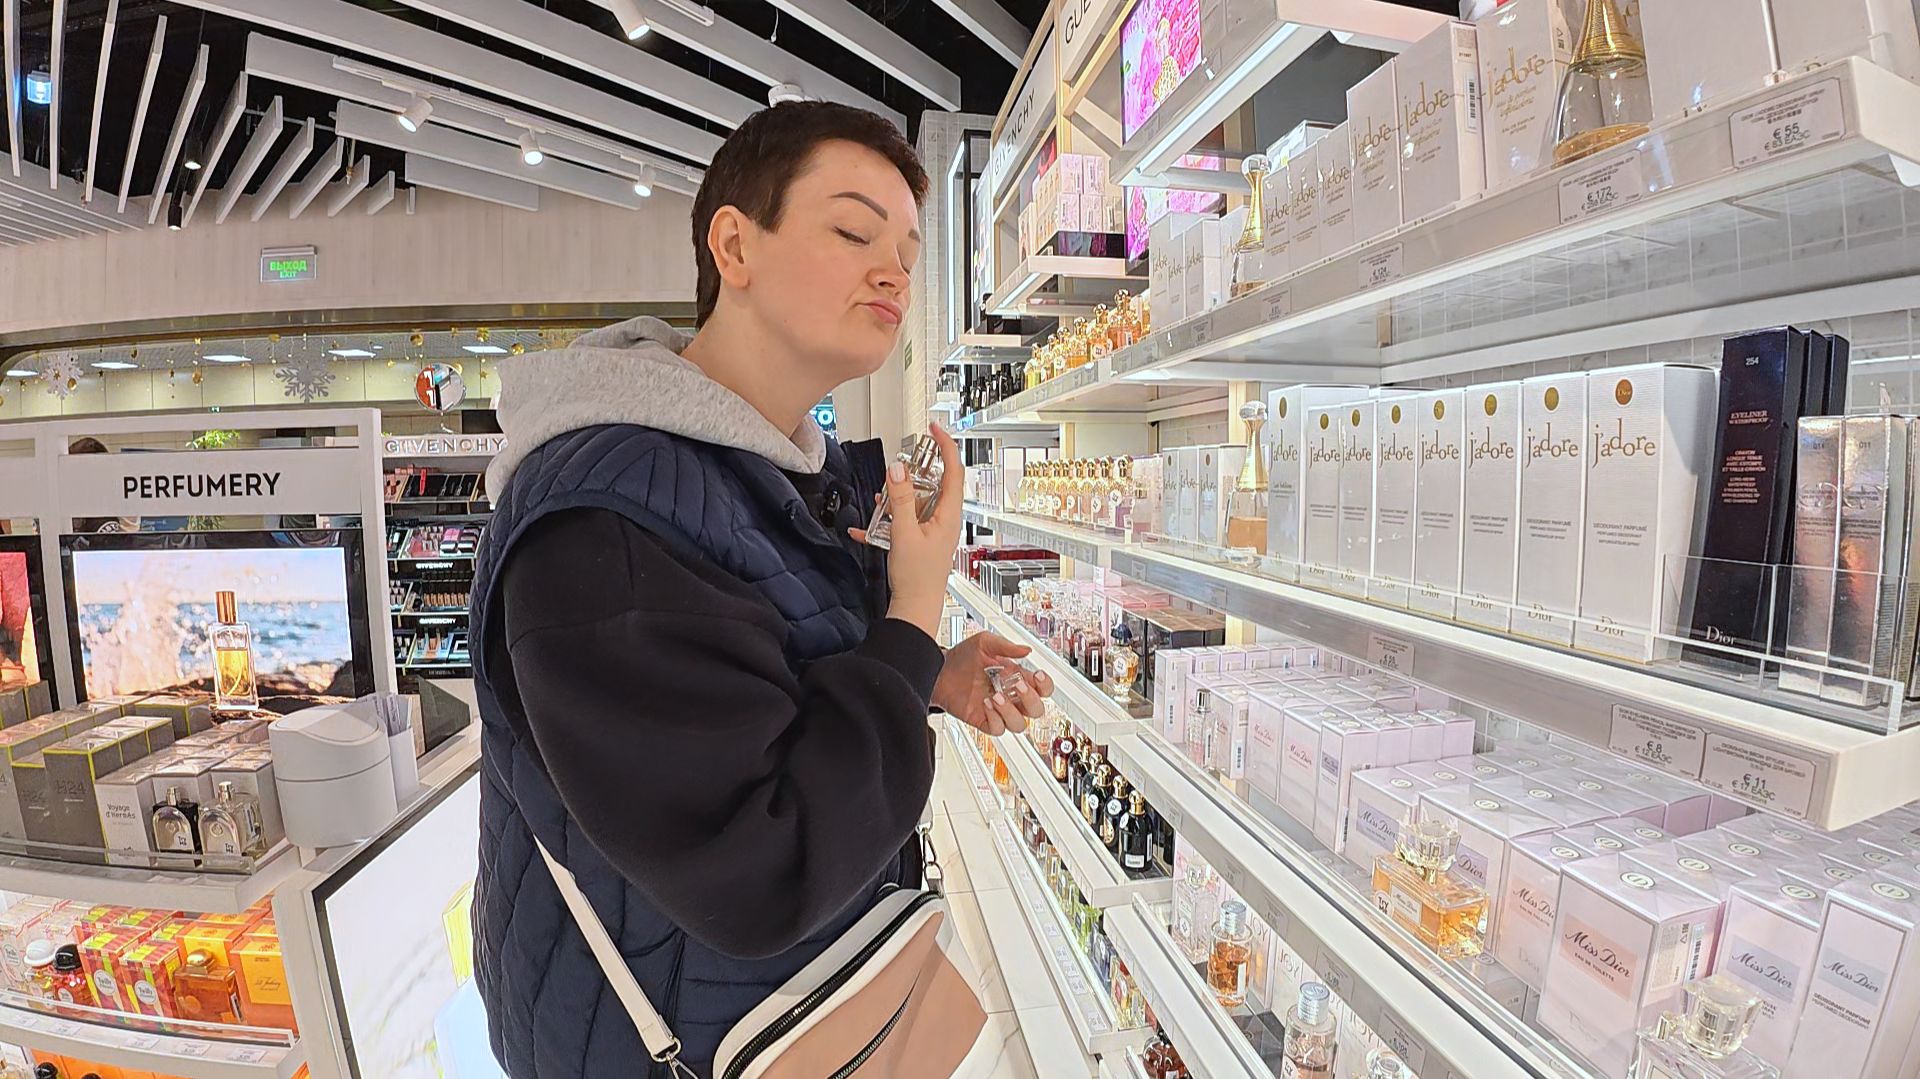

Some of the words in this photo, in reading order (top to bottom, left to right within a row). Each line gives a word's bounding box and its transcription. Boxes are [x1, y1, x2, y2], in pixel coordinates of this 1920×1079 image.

[1487, 46, 1546, 111] j'adore
[1405, 81, 1450, 134] j'adore
[994, 88, 1036, 176] GIVENCHY
[1353, 116, 1391, 163] j'adore
[1773, 127, 1781, 139] €
[1785, 122, 1800, 137] 55
[1597, 186, 1612, 199] 172
[270, 260, 306, 271] ВЫХОД
[1745, 356, 1759, 366] 254
[1731, 410, 1768, 419] EYELINER
[385, 438, 508, 454] GIVENCHY
[1270, 428, 1298, 473] j'adore
[1308, 437, 1341, 469] j'adore
[1342, 434, 1372, 469] j'adore
[1379, 432, 1414, 469] j'adore
[1420, 429, 1459, 469] j'adore
[1469, 426, 1514, 469] j'adore
[1526, 422, 1579, 468] j'adore
[1592, 417, 1656, 469] j'adore
[123, 472, 281, 499] PERFUMERY
[1706, 625, 1737, 645] Dior
[1646, 740, 1654, 751] €
[1655, 743, 1662, 754] 8
[1755, 777, 1766, 790] 11
[1361, 810, 1379, 828] Miss
[1459, 854, 1485, 881] Dior
[1513, 887, 1538, 909] Miss
[1538, 900, 1555, 919] Di
[1280, 949, 1298, 977] JOY
[1565, 931, 1599, 957] Miss
[1599, 948, 1630, 979] Dior
[1574, 951, 1586, 961] EAU
[1592, 963, 1615, 983] TOILETTE
[1732, 953, 1764, 974] Miss
[1764, 965, 1793, 989] Dior
[1823, 962, 1853, 981] Miss
[1853, 972, 1879, 993] Dior
